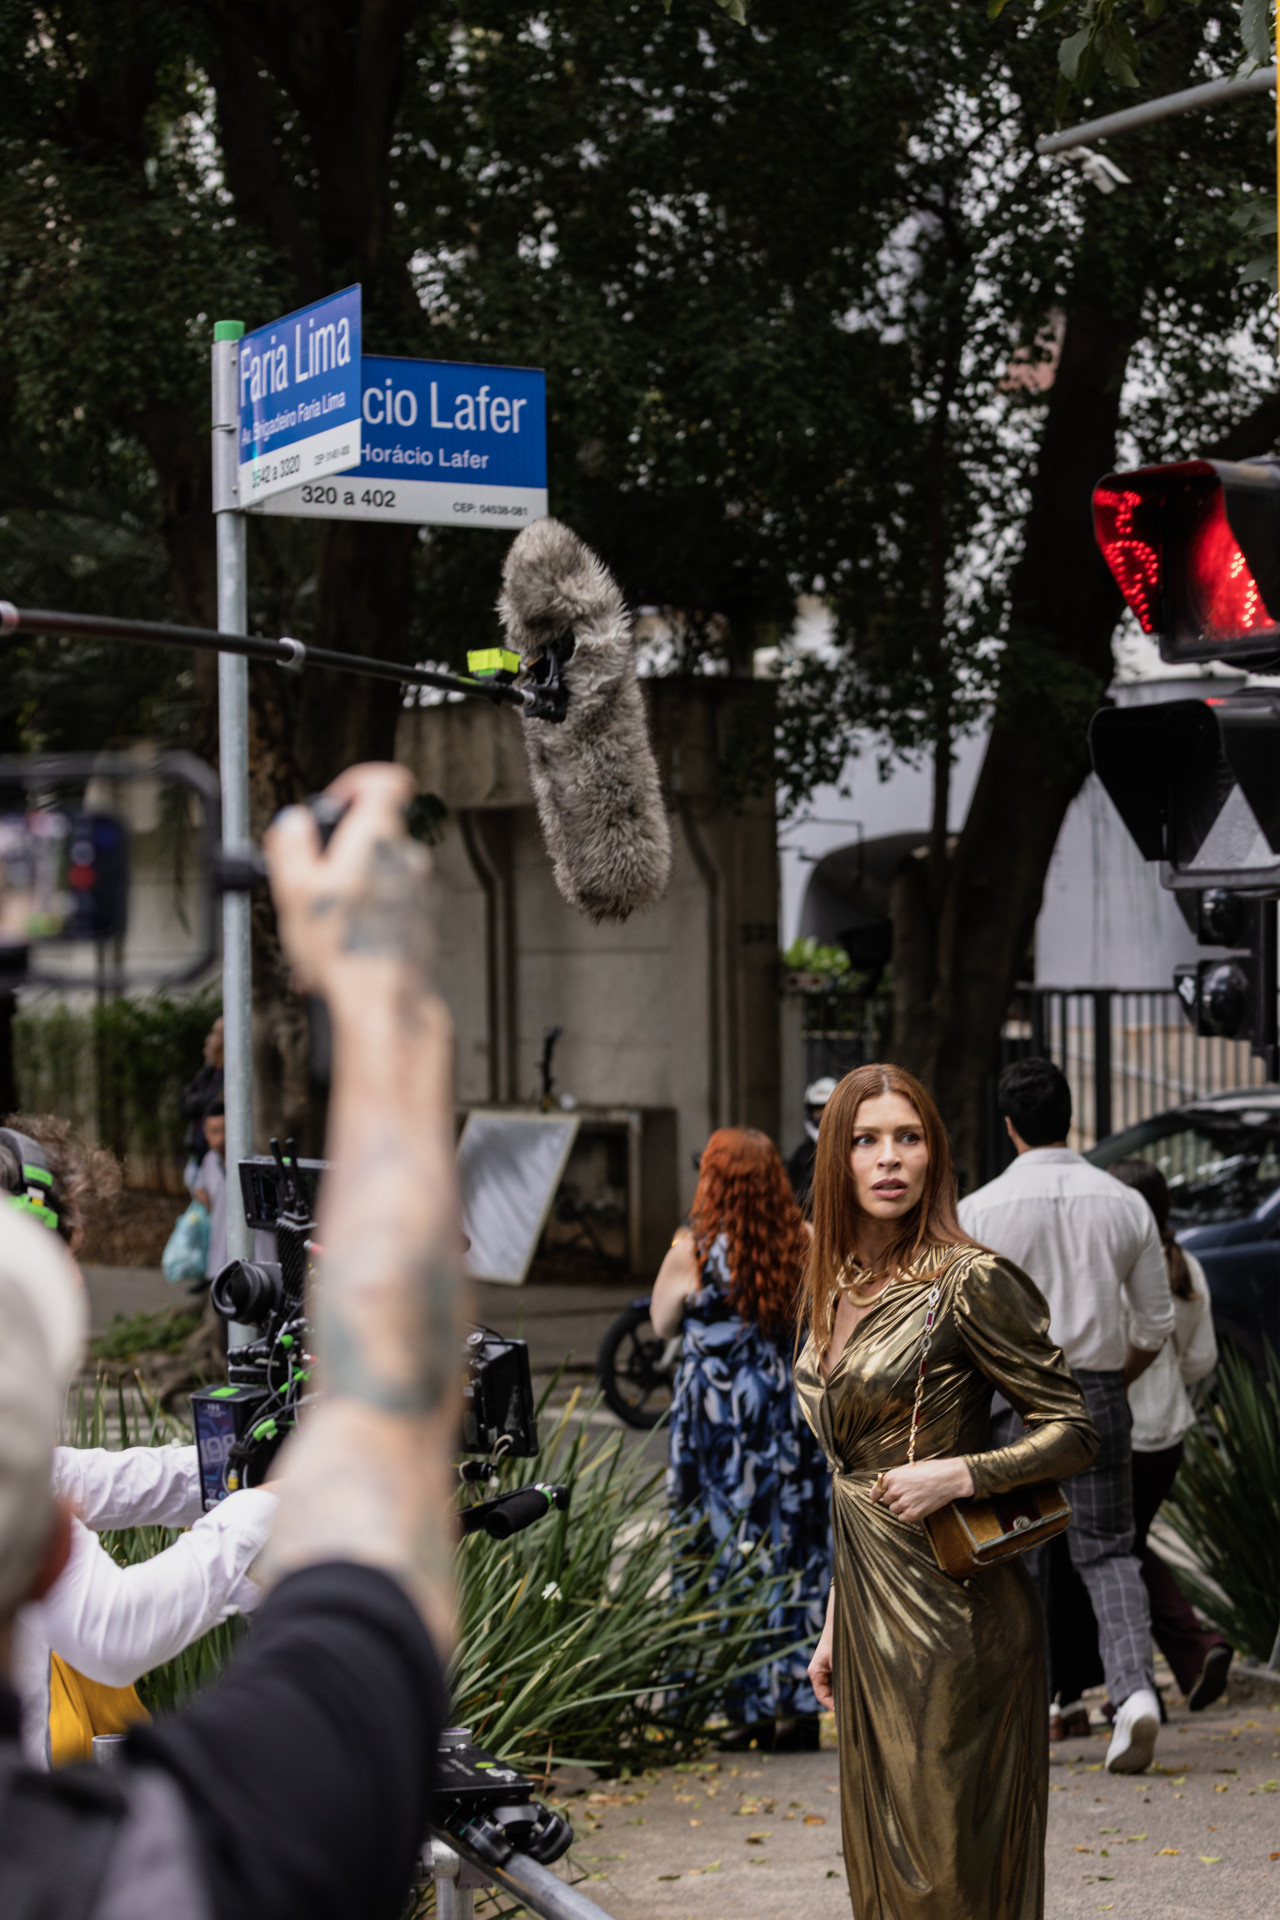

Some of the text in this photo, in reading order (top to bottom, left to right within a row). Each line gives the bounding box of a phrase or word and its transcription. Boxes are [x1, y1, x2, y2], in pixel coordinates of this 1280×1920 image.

[240, 317, 351, 408] Faria Lima
[253, 409, 297, 442] Brigadeiro
[298, 398, 321, 424] Faria
[322, 391, 346, 414] Lima
[430, 381, 527, 433] Lafer
[273, 466, 278, 480] a
[280, 454, 300, 478] 3320
[361, 443, 489, 469] Horácio Lafer
[301, 485, 396, 508] 320 a 402
